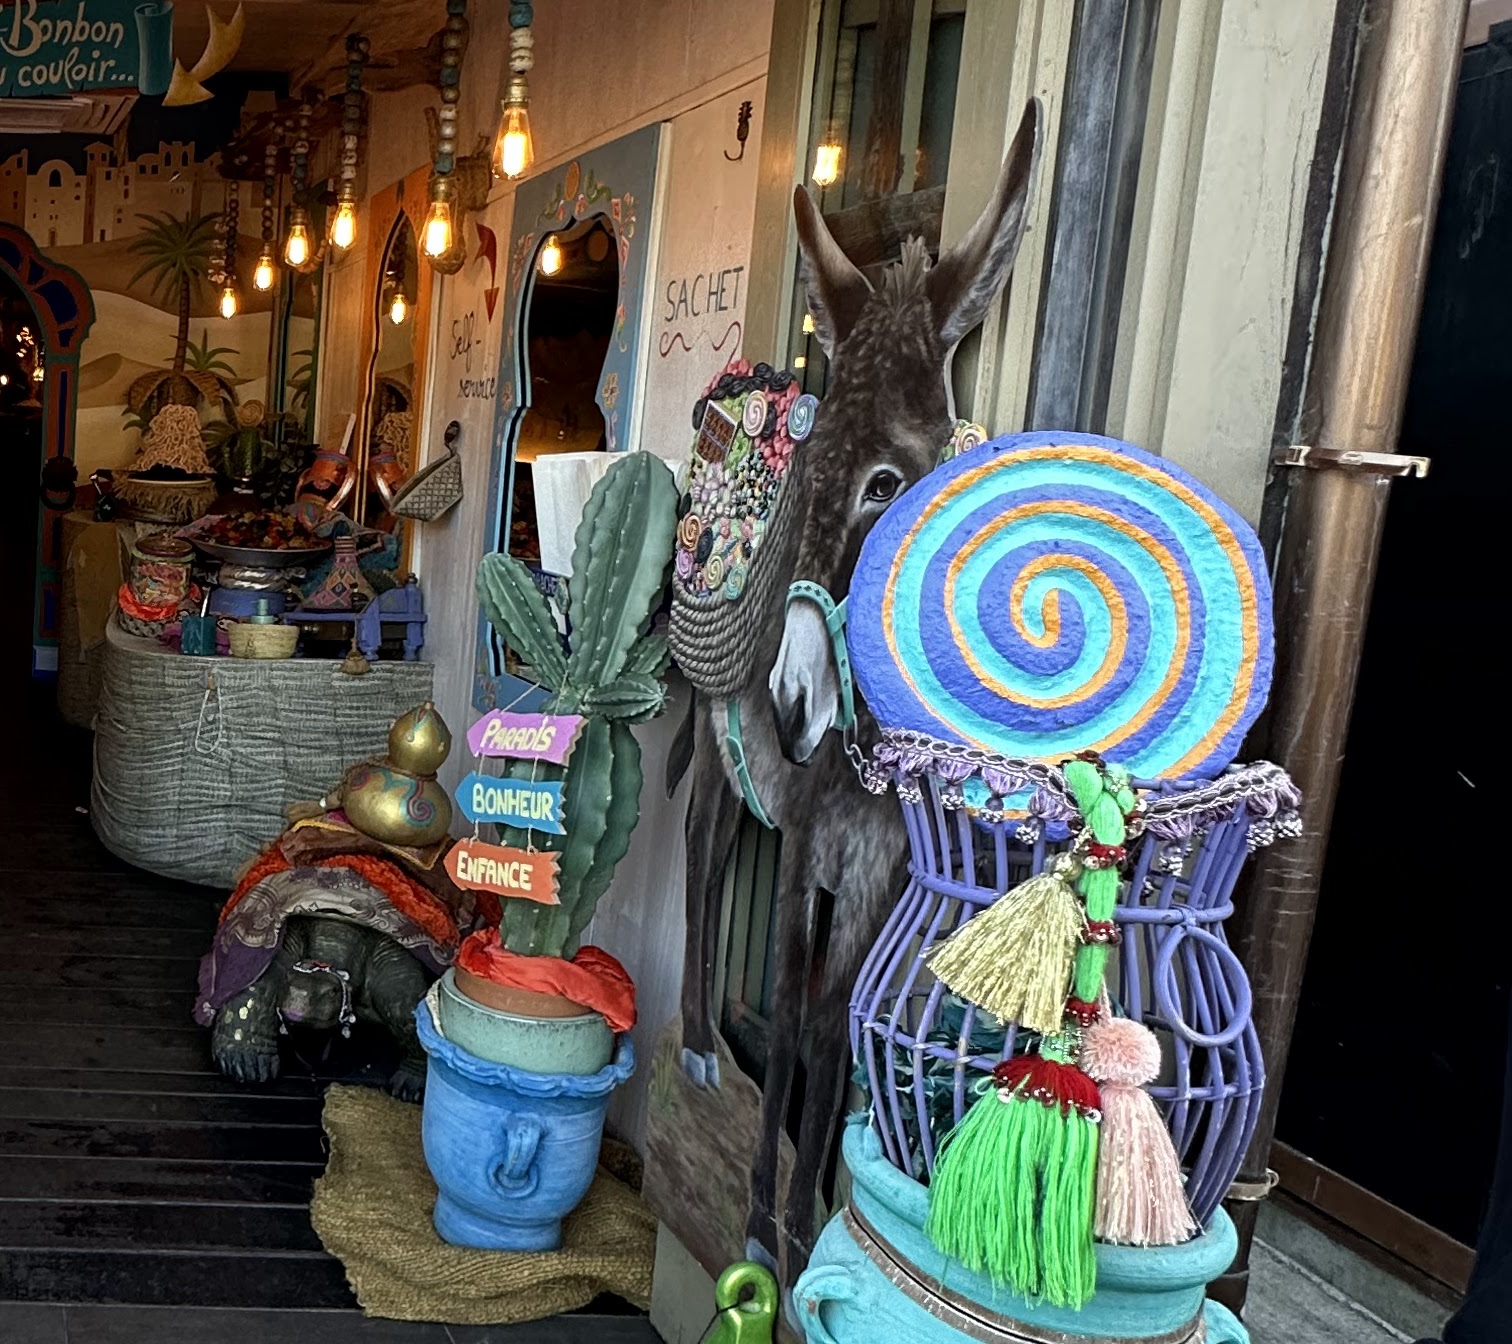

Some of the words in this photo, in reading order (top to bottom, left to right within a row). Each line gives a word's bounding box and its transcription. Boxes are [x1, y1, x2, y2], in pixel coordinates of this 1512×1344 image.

[664, 265, 745, 323] SACHET
[472, 782, 555, 822] BONHEUR
[456, 850, 533, 891] ENFANCE
